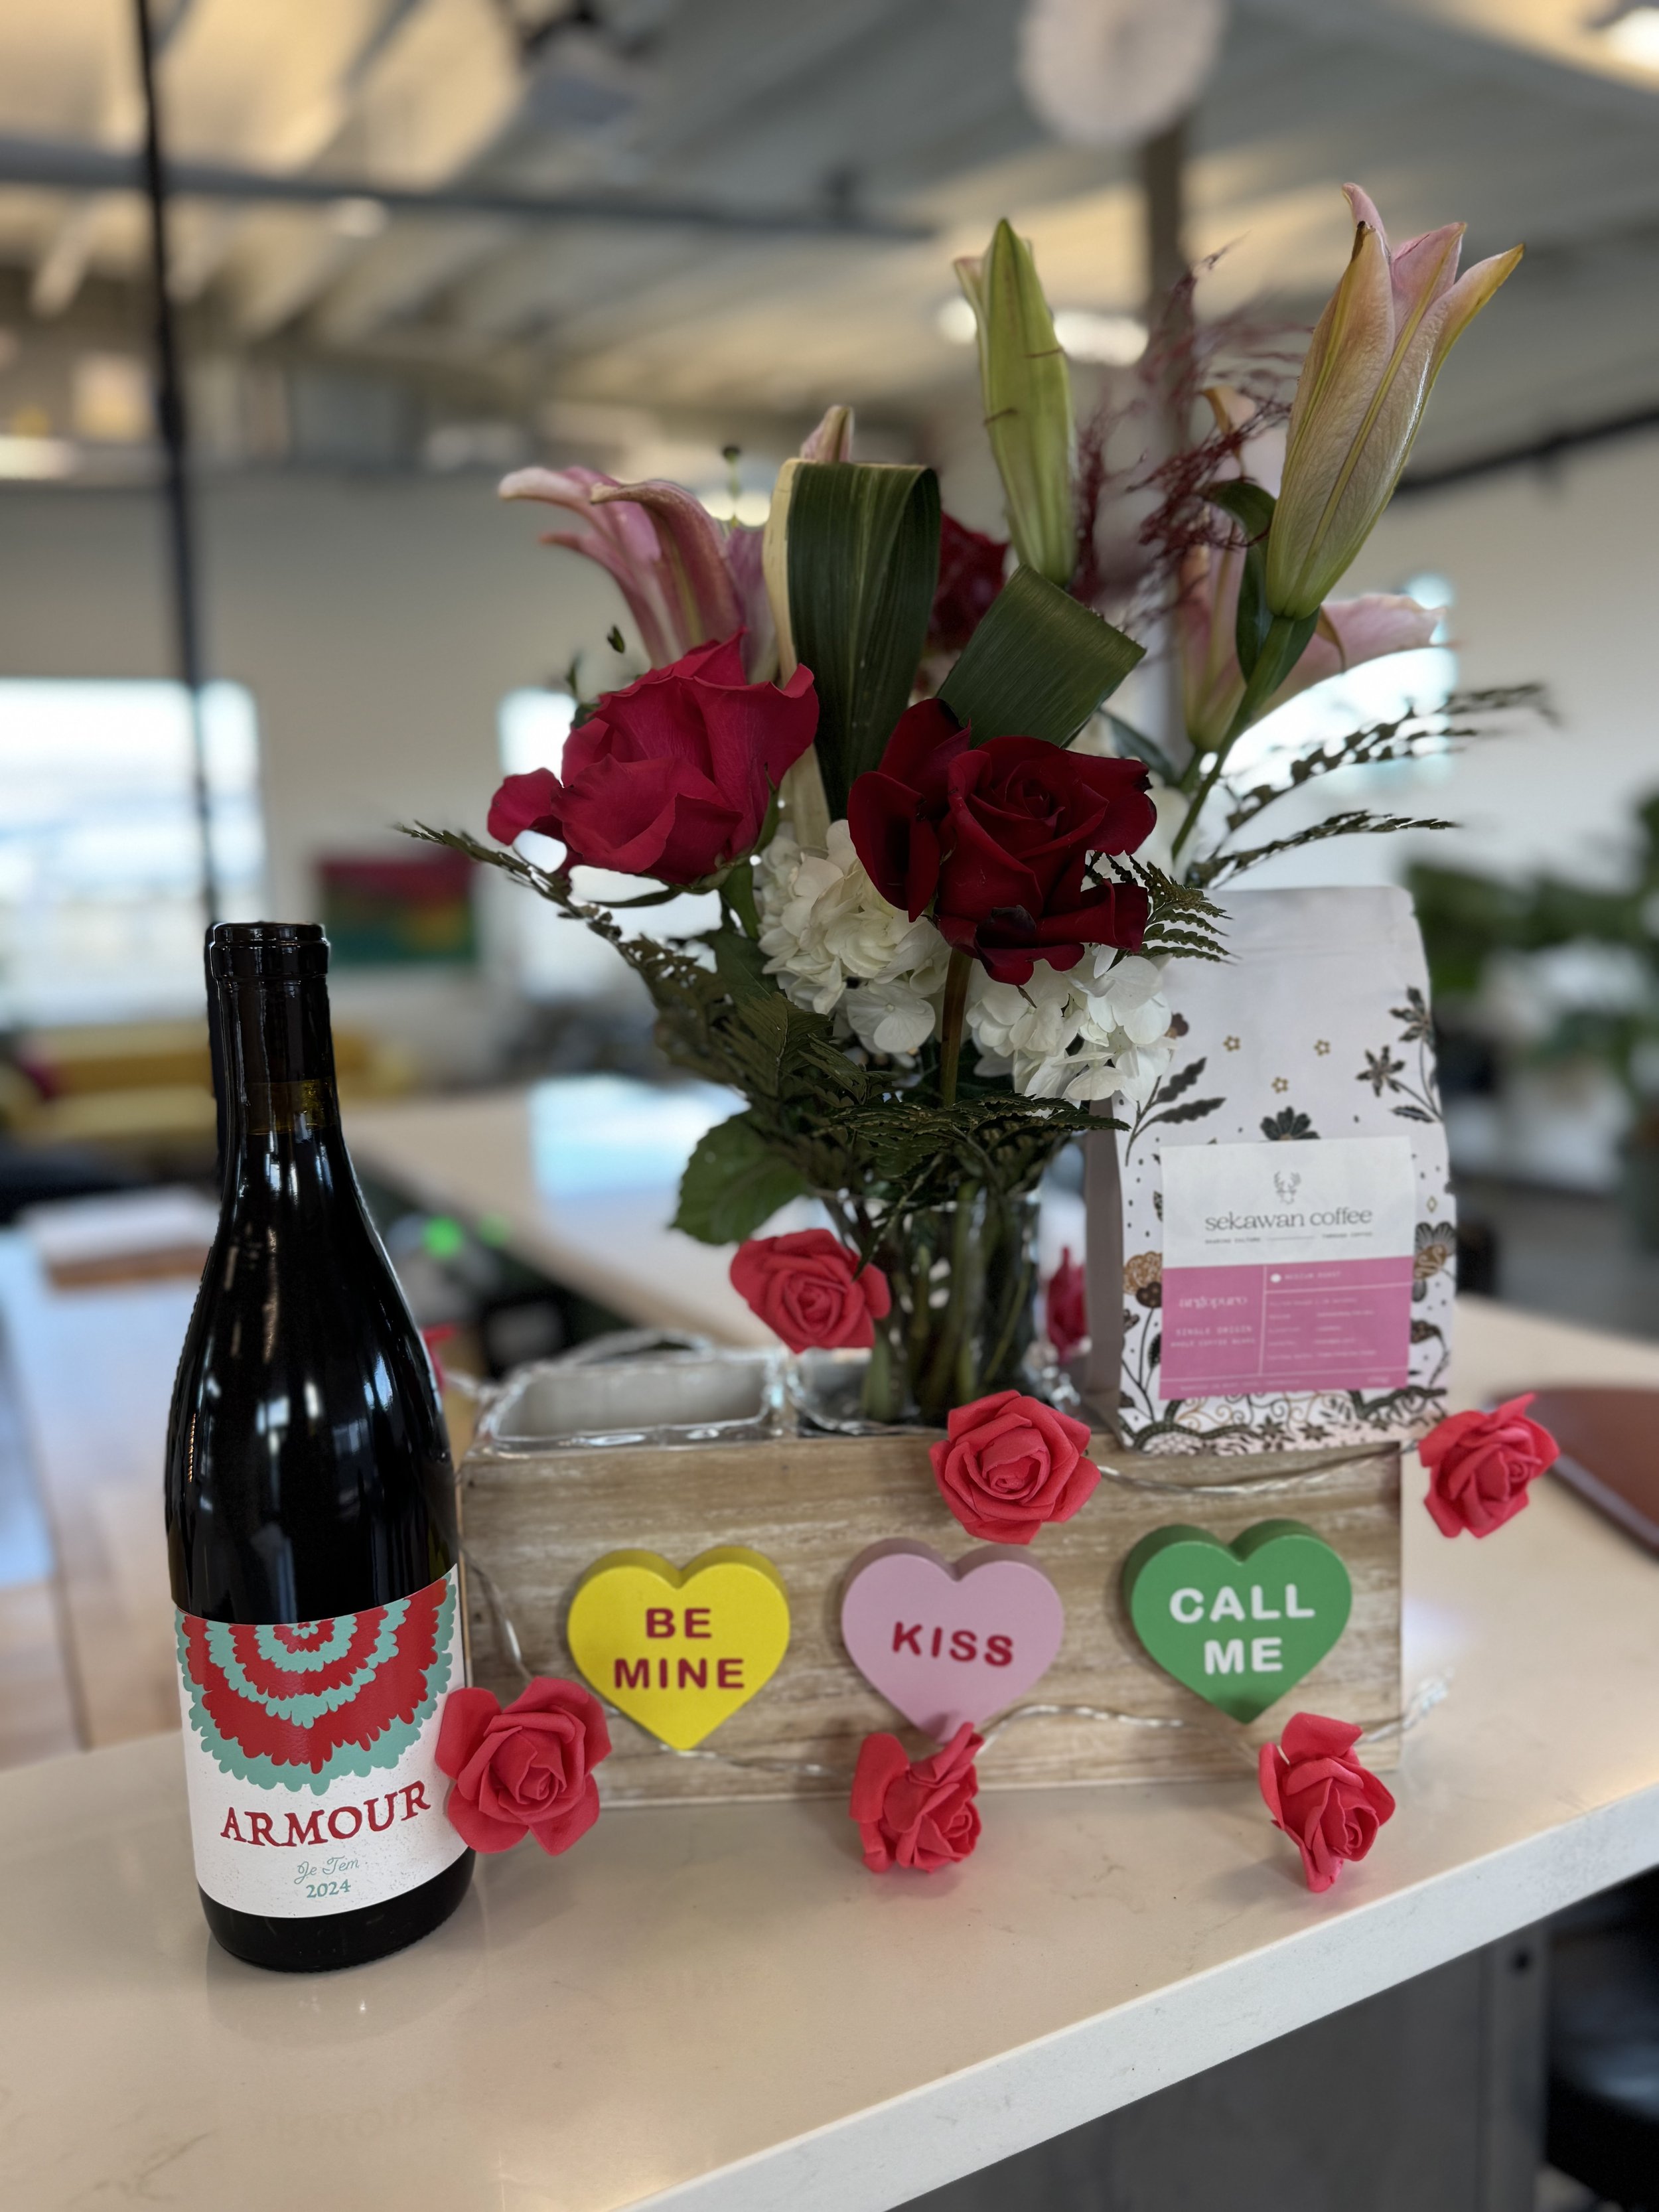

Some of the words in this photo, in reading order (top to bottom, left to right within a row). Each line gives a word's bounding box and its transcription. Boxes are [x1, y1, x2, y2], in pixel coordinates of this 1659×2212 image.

[1204, 1211, 1305, 1232] sekawan
[1309, 1207, 1373, 1226] coffee
[1169, 1583, 1316, 1624] CALL
[646, 1607, 712, 1639] BE
[893, 1621, 1013, 1668] KISS
[1204, 1637, 1283, 1676] ME
[614, 1658, 745, 1690] MINE
[220, 1780, 431, 1847] ARMOUR
[305, 1878, 352, 1899] 2024
